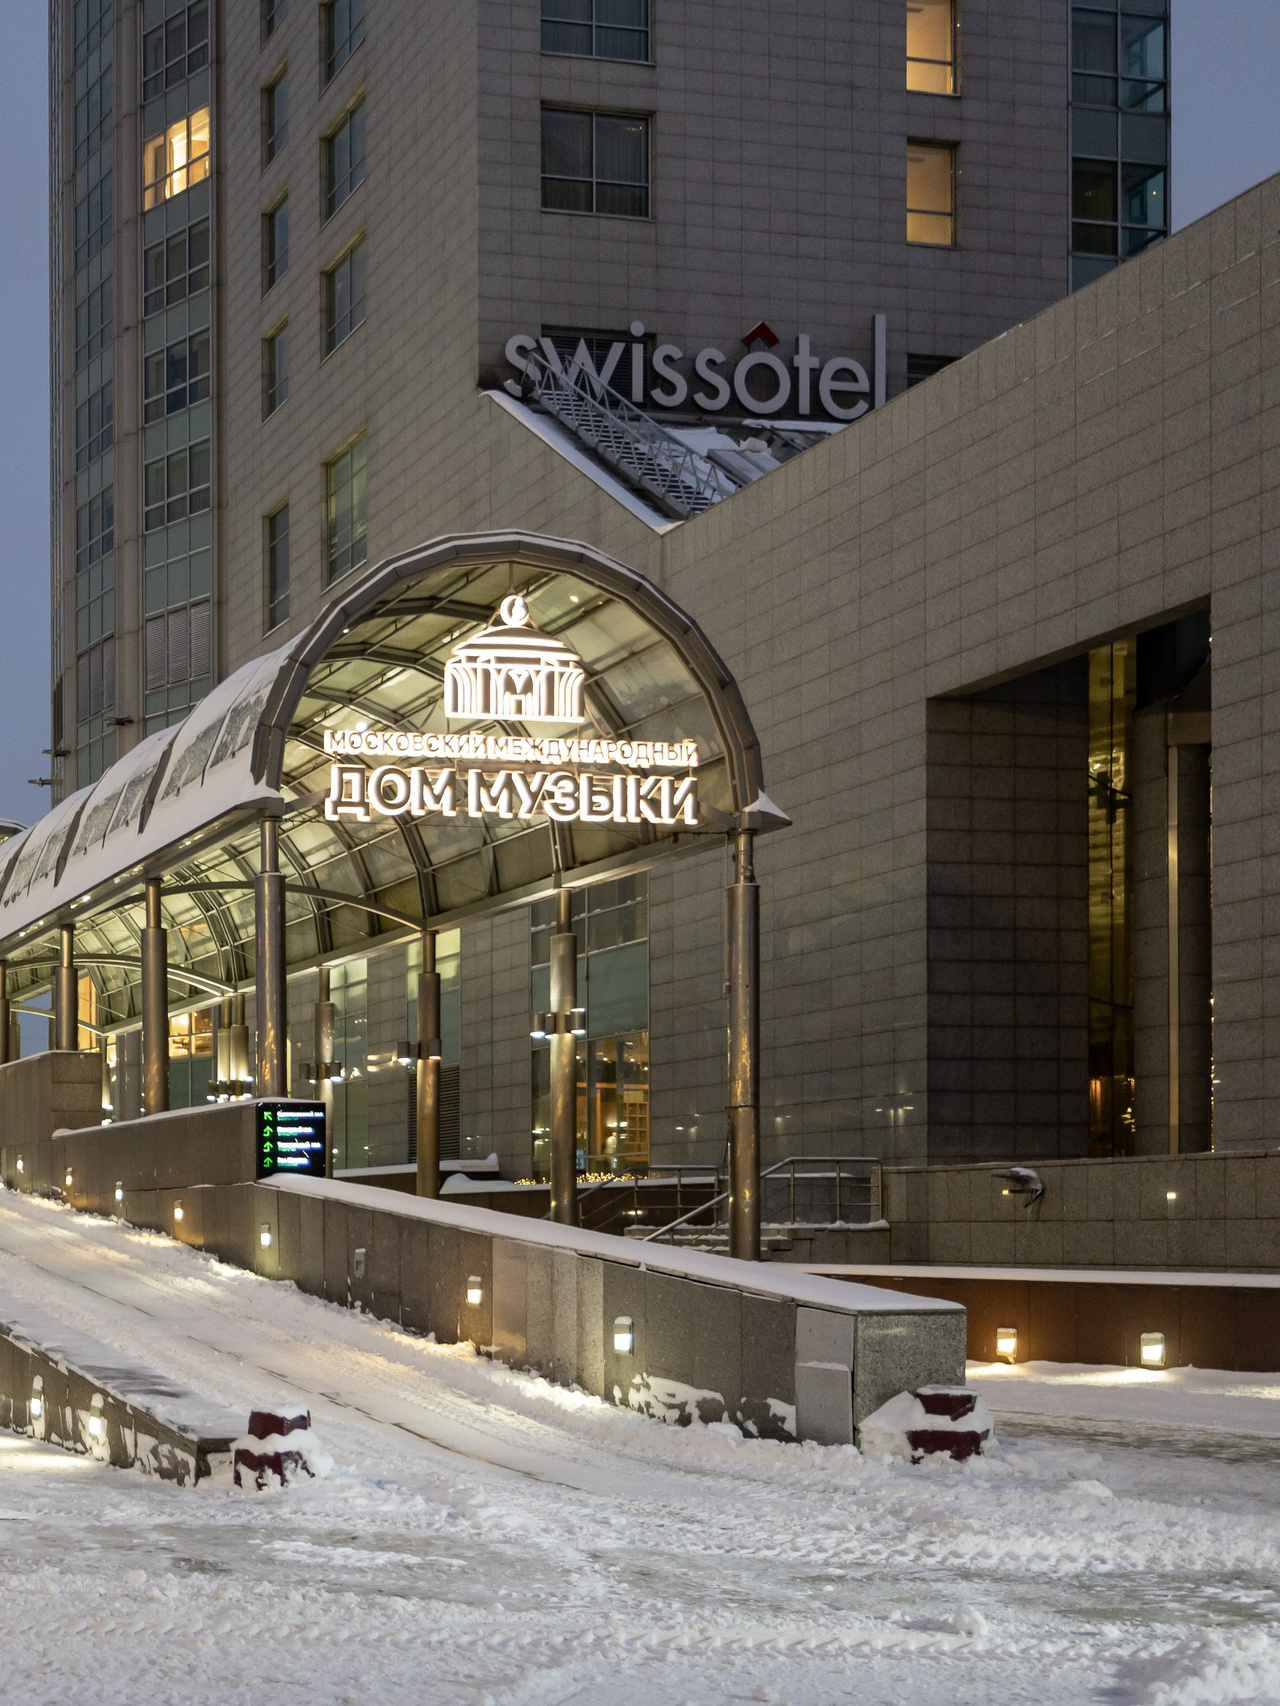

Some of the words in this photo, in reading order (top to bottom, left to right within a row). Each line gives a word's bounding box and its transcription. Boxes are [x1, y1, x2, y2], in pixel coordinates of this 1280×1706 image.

[324, 730, 487, 758] МОСКОВСКИЙ
[488, 737, 699, 768] МЕЖДУНАРОДНЫЙ
[325, 765, 456, 822] ДОМ
[468, 769, 698, 824] МУЗЫКИ
